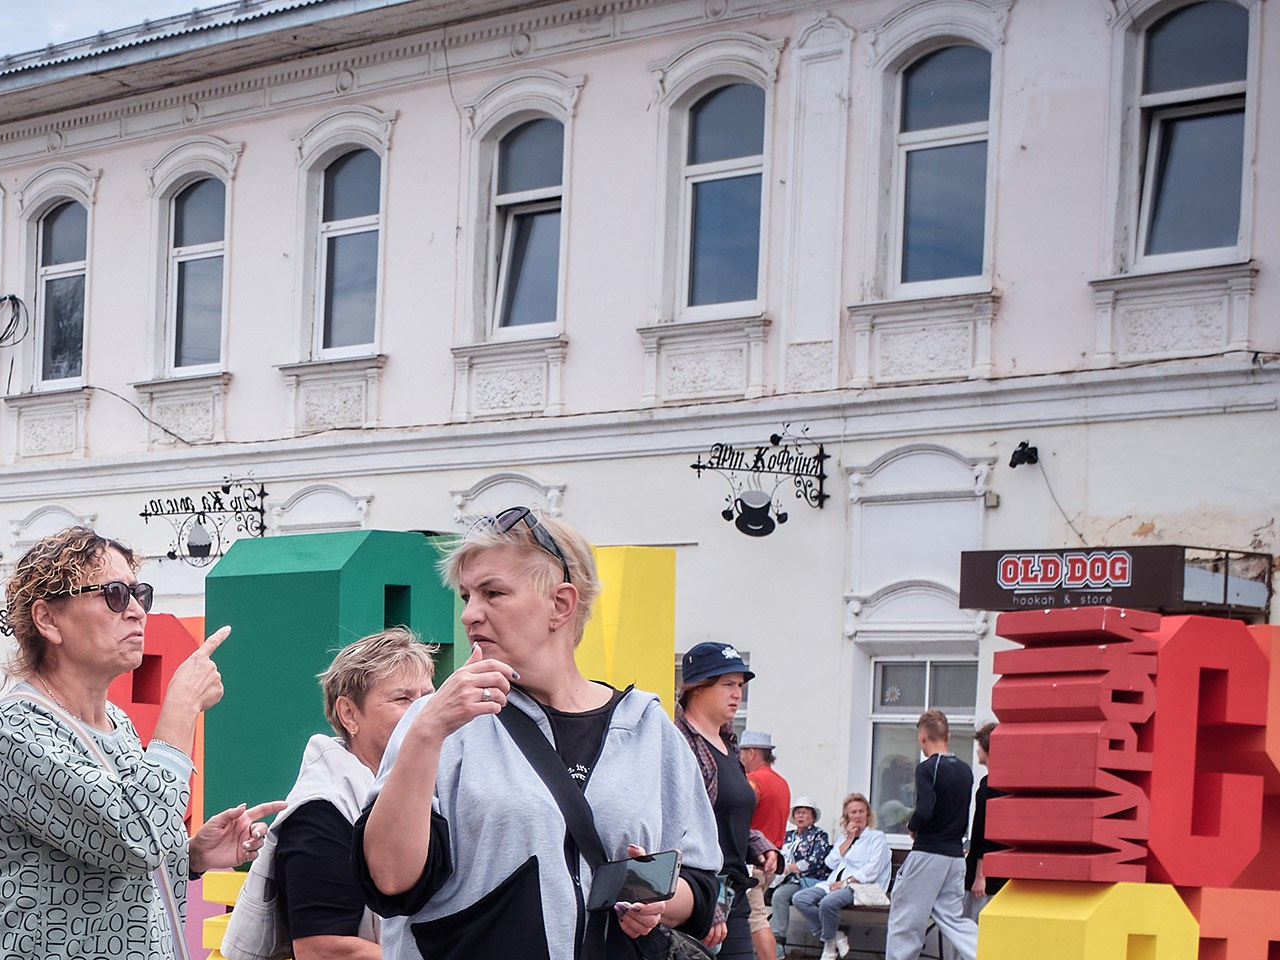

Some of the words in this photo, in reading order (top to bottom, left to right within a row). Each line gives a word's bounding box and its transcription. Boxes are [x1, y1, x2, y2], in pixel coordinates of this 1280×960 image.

[999, 554, 1062, 587] OLD
[1064, 553, 1131, 586] DOG
[1012, 595, 1055, 606] hookah
[1064, 595, 1071, 605] &
[1080, 594, 1113, 605] store
[71, 818, 126, 863] CICLO
[71, 913, 124, 935] CICLO
